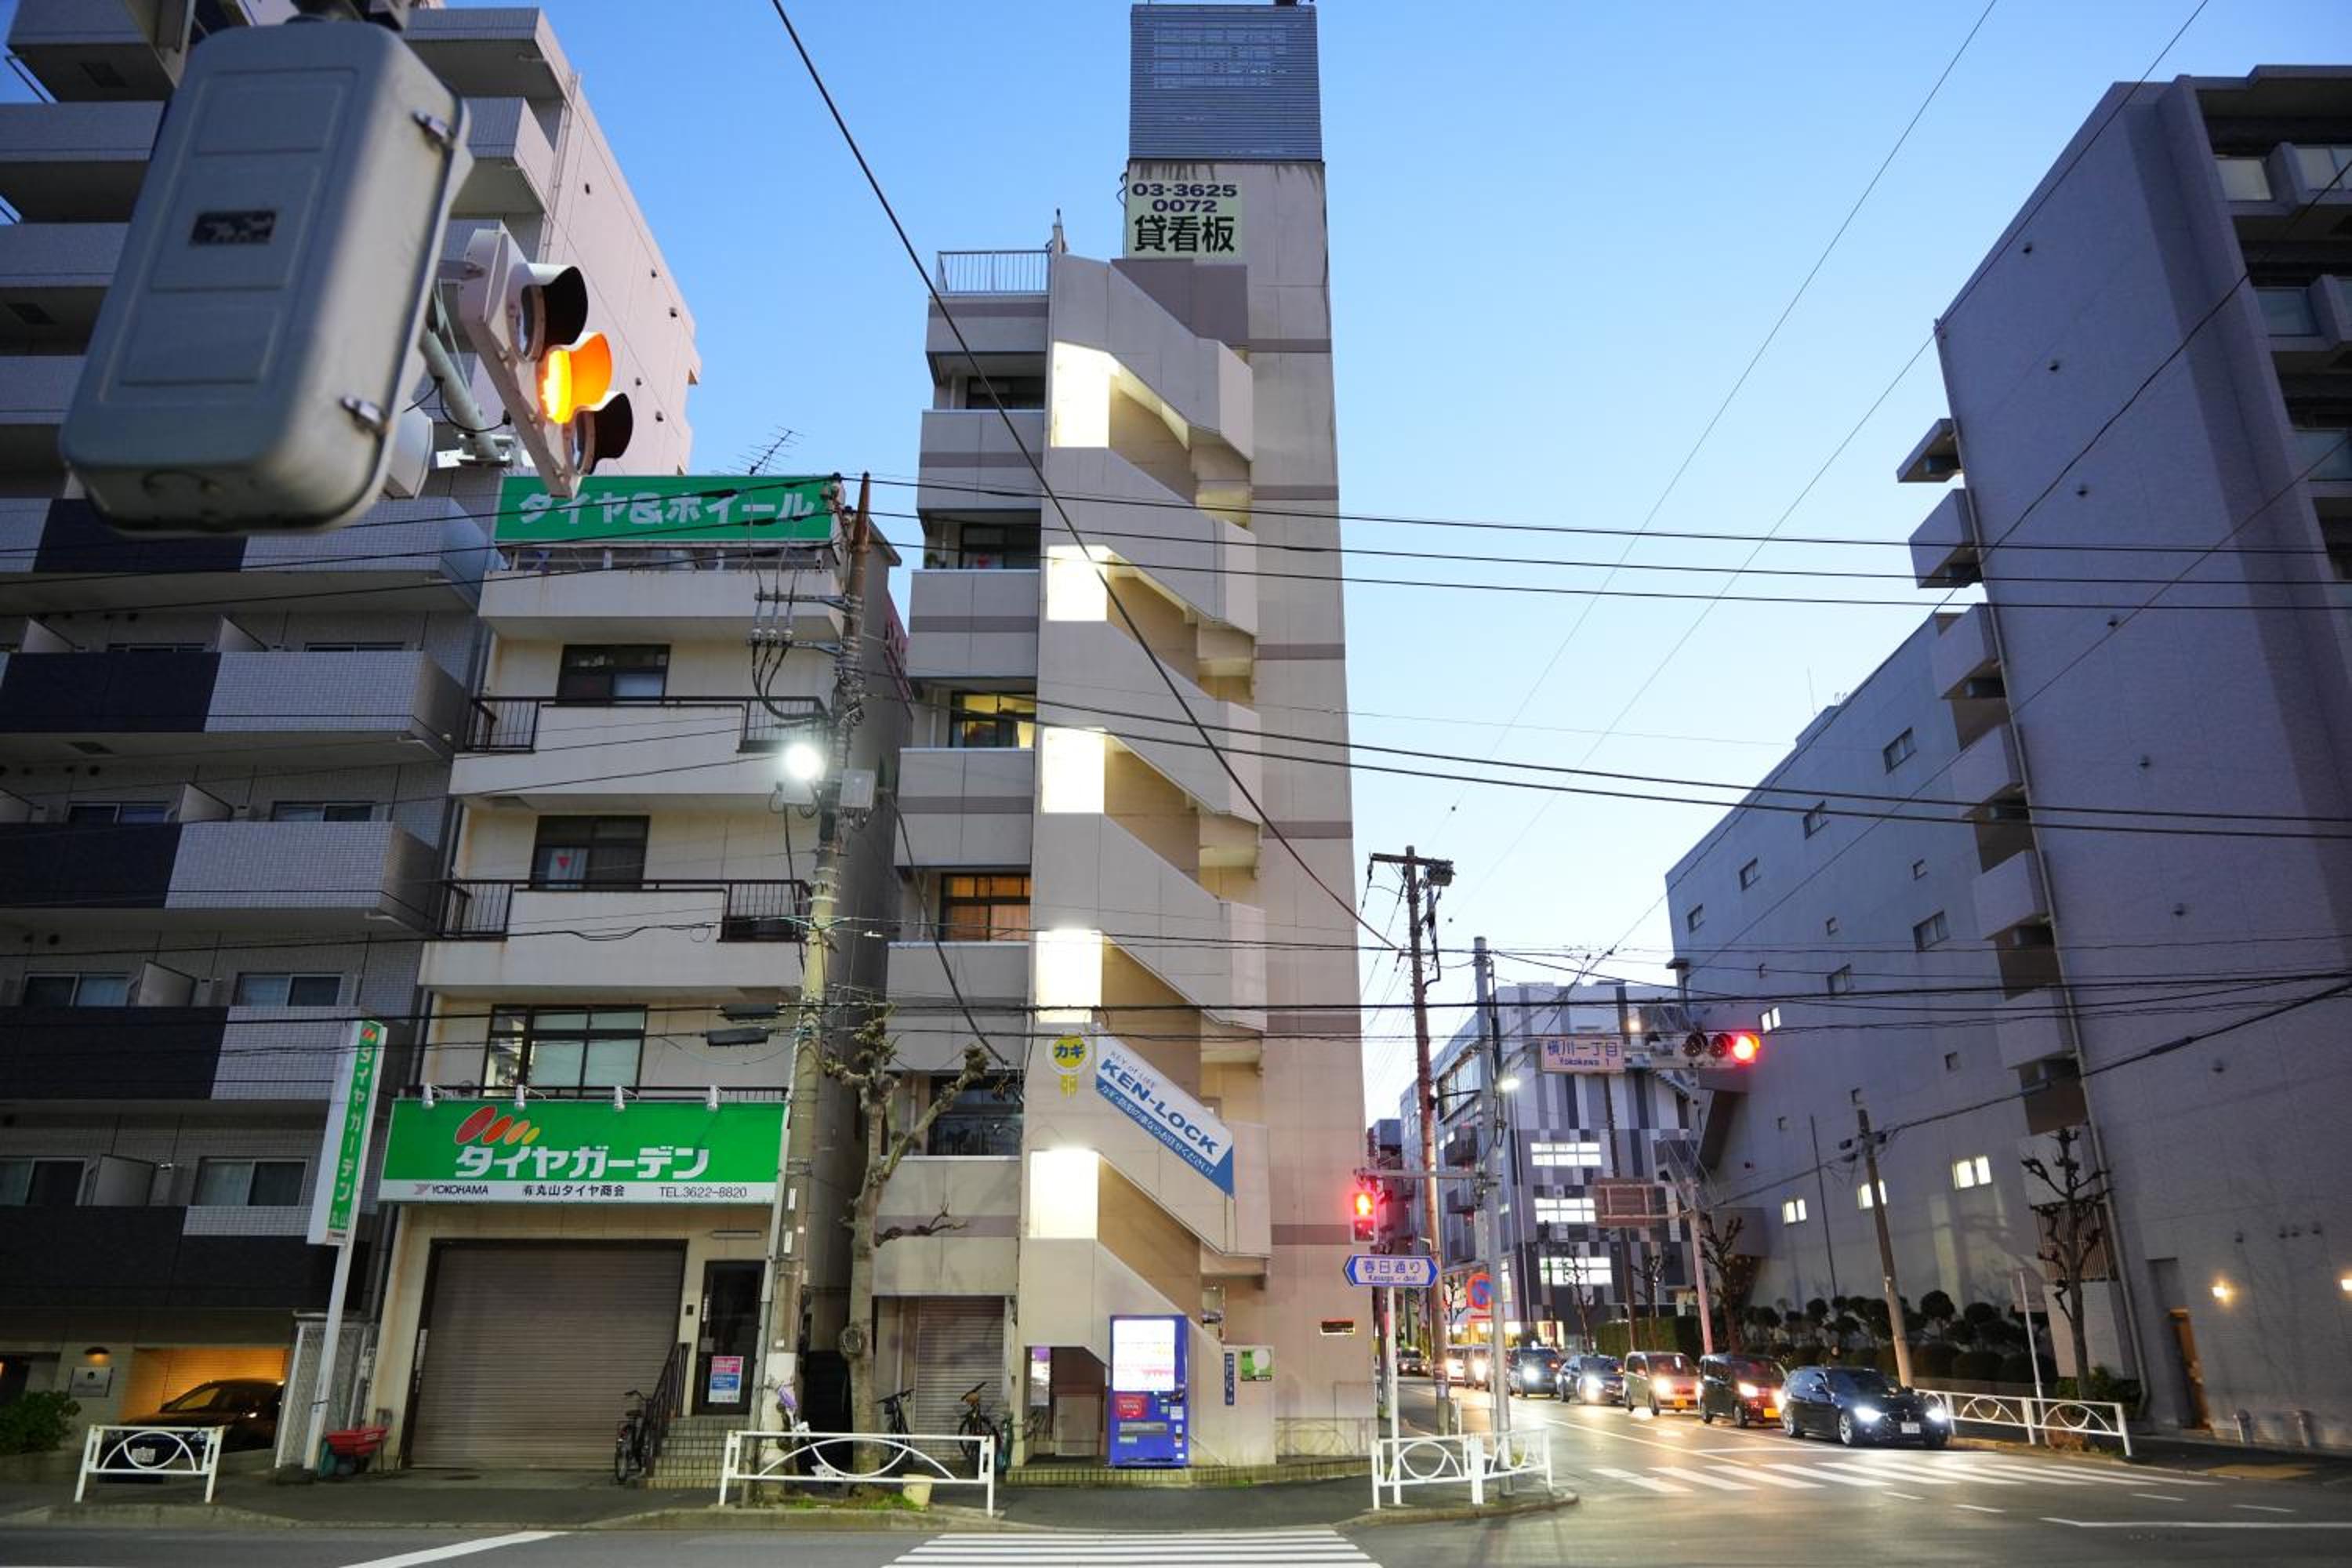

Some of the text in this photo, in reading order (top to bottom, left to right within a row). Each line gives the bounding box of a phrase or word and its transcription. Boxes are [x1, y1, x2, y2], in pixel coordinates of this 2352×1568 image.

[1131, 183, 1237, 197] 03-3625
[1152, 199, 1218, 212] 0072
[1134, 215, 1235, 252] 貸看板
[1054, 1044, 1085, 1058] カギ
[1547, 1040, 1617, 1056] 横川一丁目
[1101, 1058, 1219, 1155] KEN-LOCK
[456, 1145, 710, 1179] タイヤガーデン
[432, 1185, 489, 1196] YOKOHAMA
[1364, 1260, 1421, 1274] 春日通り
